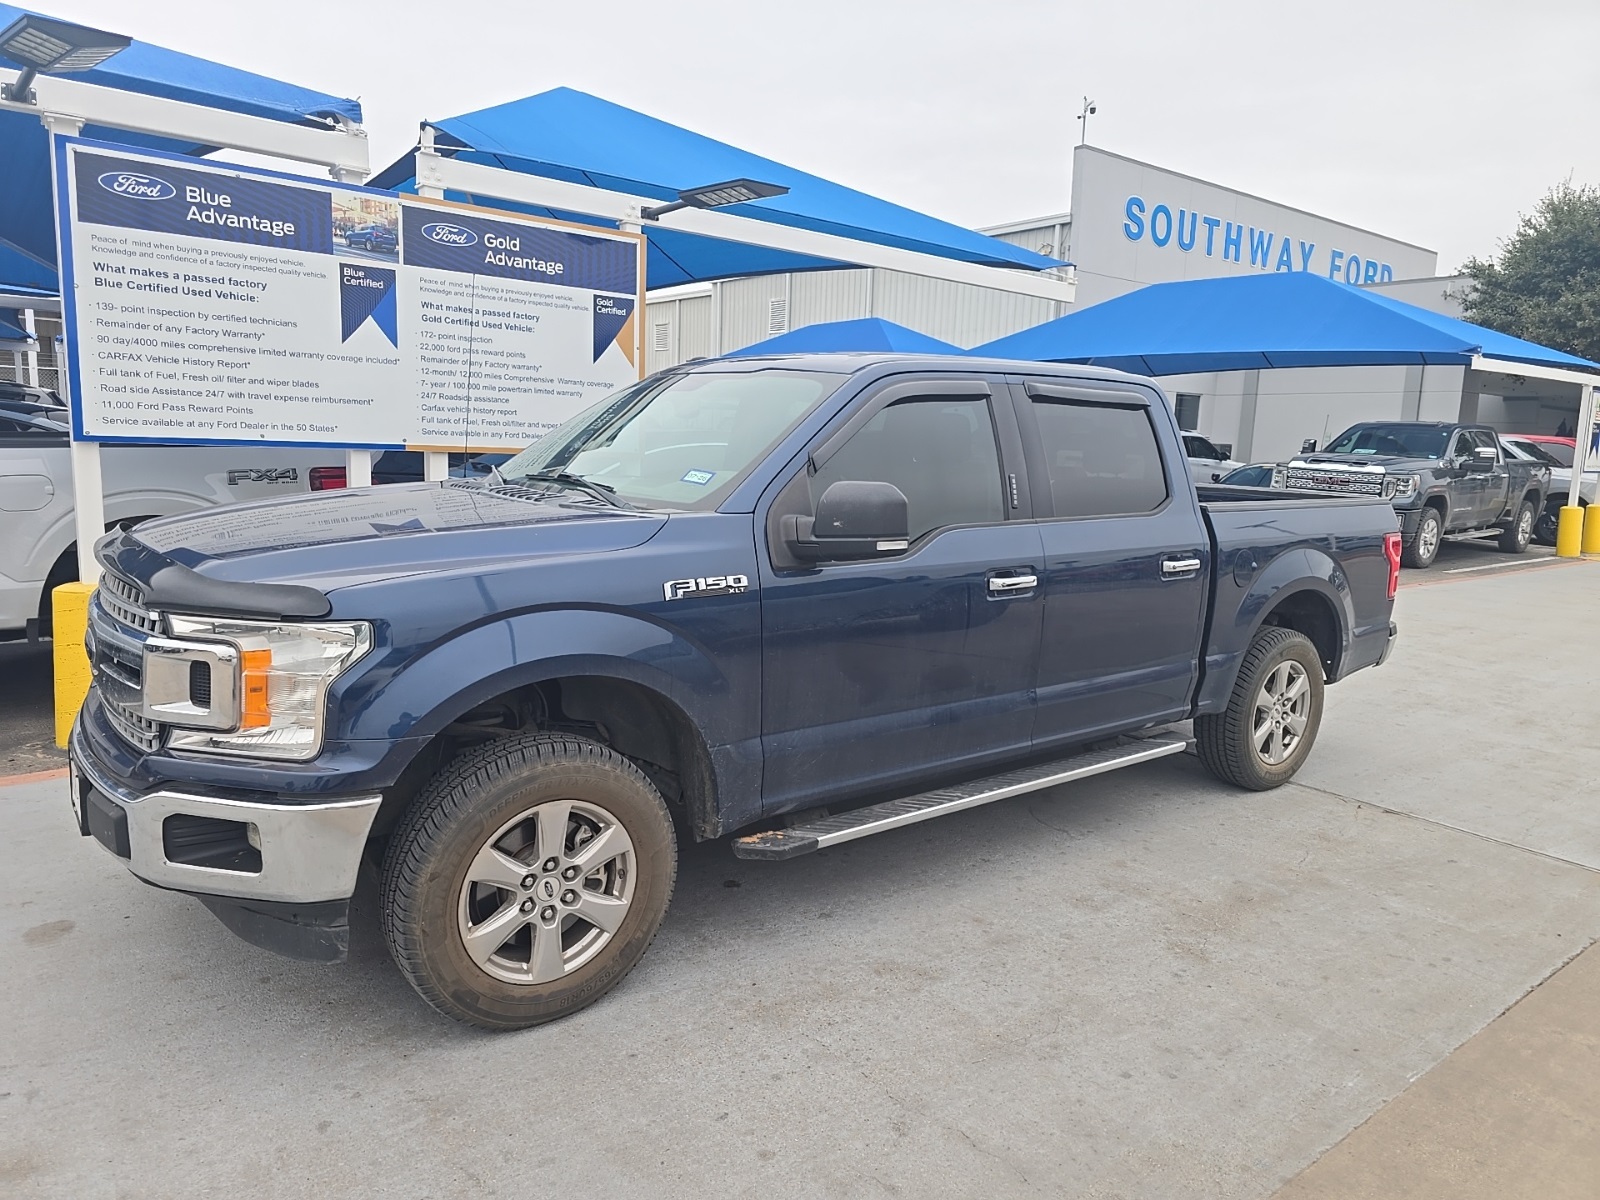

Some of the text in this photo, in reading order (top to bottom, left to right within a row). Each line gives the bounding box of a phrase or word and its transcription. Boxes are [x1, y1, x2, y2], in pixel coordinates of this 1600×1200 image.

[113, 173, 162, 198] Ford
[185, 186, 232, 208] Blue
[186, 205, 295, 237] Advantage
[432, 225, 468, 244] Ford
[484, 233, 520, 252] Gold
[1123, 195, 1393, 285] SOUTHWAY FORD
[90, 233, 117, 244] Peace
[118, 237, 127, 245] of
[131, 239, 151, 248] mind
[152, 242, 174, 250] when
[176, 244, 202, 255] buying
[210, 250, 248, 261] previously
[248, 255, 278, 264] enjoyed
[90, 244, 137, 257] Knowledge
[155, 253, 198, 263] confidence
[215, 259, 241, 270] factory
[241, 262, 277, 273] inspected
[277, 268, 301, 277] quality
[484, 252, 564, 274] Advantage
[92, 261, 267, 291] What makes a passed factory
[343, 267, 365, 279] Blue
[343, 276, 384, 290] Certified
[93, 276, 259, 302] Blue Certified Used Vehicle:
[420, 300, 443, 311] What
[445, 304, 472, 314] makes
[481, 309, 511, 318] passed
[512, 311, 540, 323] factory
[596, 298, 614, 307] Gold
[596, 305, 627, 317] Certified
[120, 304, 145, 314] point
[146, 306, 195, 318] inspection
[197, 310, 209, 321] by
[210, 313, 247, 323] certified
[248, 316, 298, 328] technicians
[420, 313, 535, 333] Gold Certified Used Vehicle:
[96, 317, 151, 330] Remainder
[152, 322, 163, 331] of
[164, 325, 182, 334] any
[184, 325, 219, 338] Factory
[96, 334, 109, 343] 90
[160, 340, 185, 349] miles
[187, 343, 256, 354] comprehensive
[258, 347, 286, 357] limited
[288, 351, 324, 361] warranty
[326, 354, 363, 363] coverage
[97, 351, 143, 362] CARFAX
[144, 354, 180, 364] Vehicle
[182, 356, 214, 368] History
[98, 366, 117, 376] Full
[119, 368, 141, 378] tank
[143, 370, 154, 378] of
[181, 372, 209, 381] Fresh
[226, 375, 246, 384] filter
[247, 377, 264, 385] and
[266, 378, 290, 387] wiper
[291, 379, 320, 388] blades
[99, 383, 126, 393] Road
[128, 385, 149, 394] side
[151, 386, 203, 397] Assistance
[226, 390, 245, 399] with
[247, 392, 271, 400] travel
[273, 394, 309, 402] expense
[101, 400, 254, 414] 11,000 Ford Pass Reward Points
[101, 416, 138, 425] Service
[141, 418, 184, 427] available
[196, 420, 214, 429] any
[216, 420, 237, 428] Ford
[239, 420, 269, 429] Dealer
[270, 422, 278, 430] in
[280, 422, 294, 430] the
[295, 423, 306, 431] 50
[226, 467, 299, 486] FX4
[1314, 476, 1349, 485] GMC
[663, 574, 749, 601] F150
